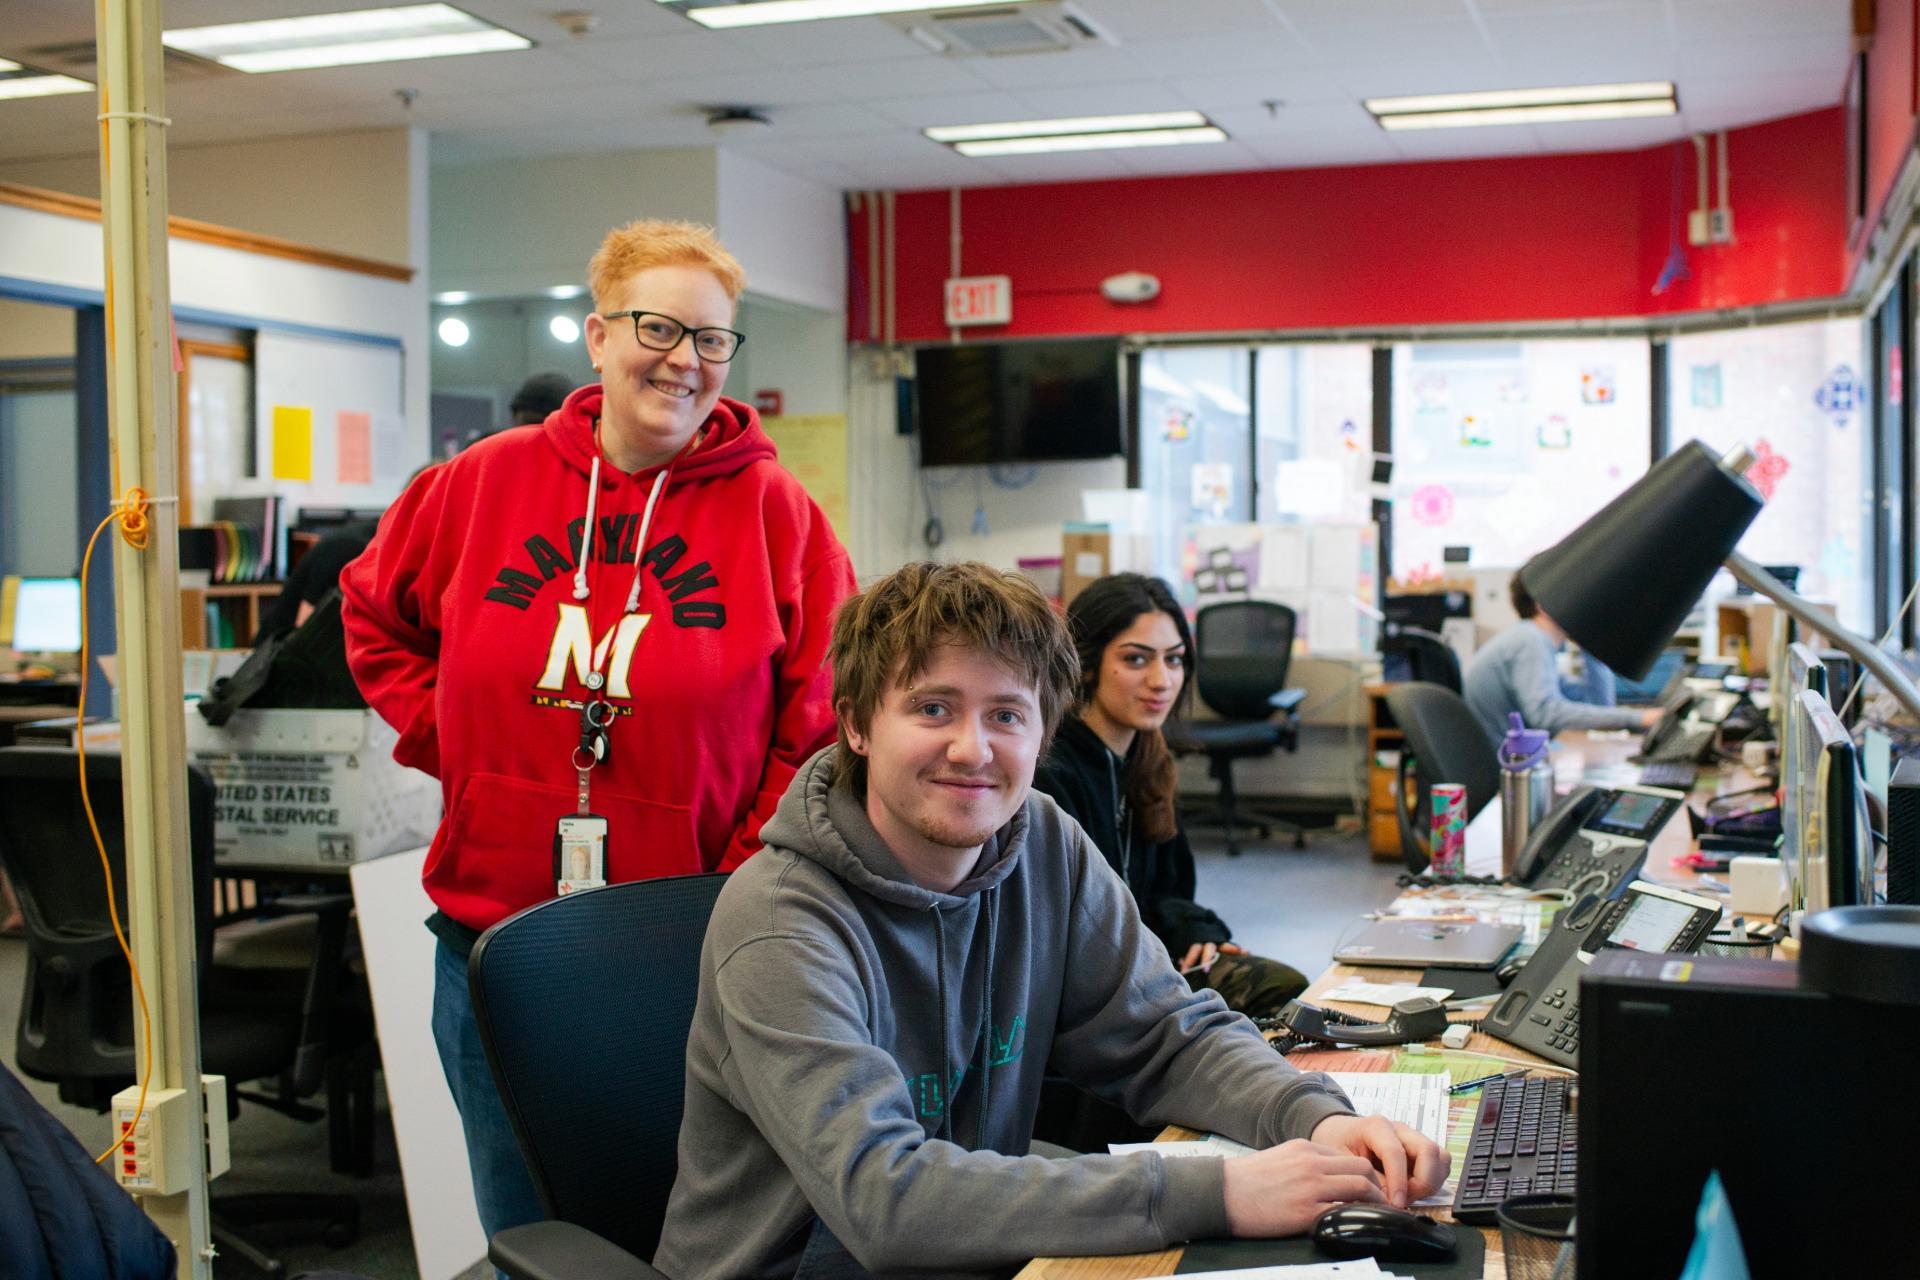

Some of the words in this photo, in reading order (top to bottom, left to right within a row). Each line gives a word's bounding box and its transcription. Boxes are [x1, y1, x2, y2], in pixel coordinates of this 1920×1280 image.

[952, 283, 997, 317] EXIT
[484, 513, 727, 630] MARYLAND
[262, 785, 331, 803] STATES
[215, 806, 257, 823] STAL
[263, 807, 339, 826] SERVICE
